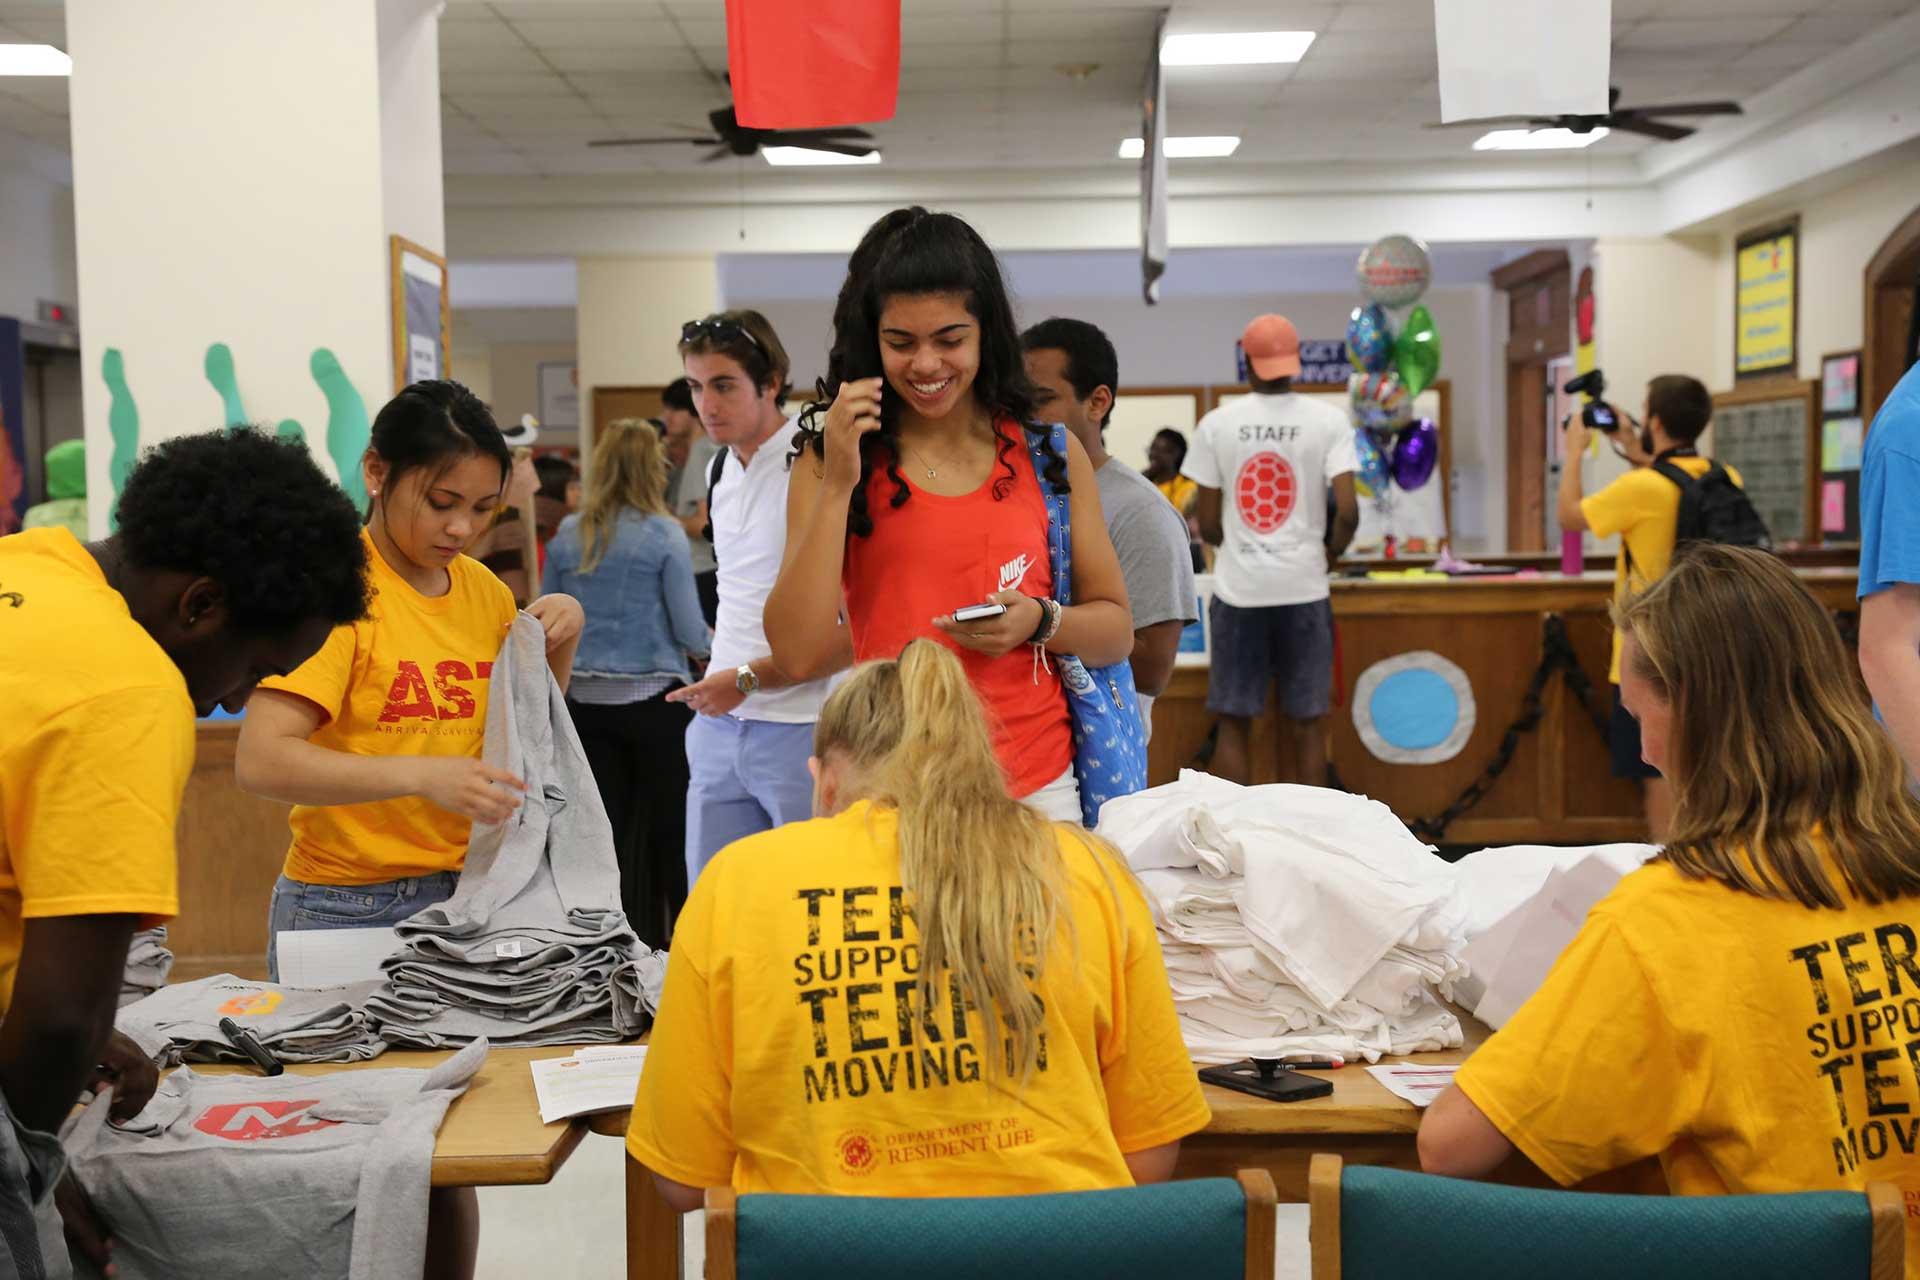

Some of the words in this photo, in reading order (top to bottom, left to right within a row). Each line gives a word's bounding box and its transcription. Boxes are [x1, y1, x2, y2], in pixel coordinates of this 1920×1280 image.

[1238, 424, 1302, 442] STAFF
[999, 553, 1026, 586] NIKE
[377, 660, 494, 723] AS
[803, 1043, 981, 1104] MOVING
[885, 1120, 993, 1146] DEPARTMENT
[999, 1116, 1019, 1131] OF
[888, 1135, 990, 1166] RESIDENT
[996, 1127, 1036, 1150] LIFE
